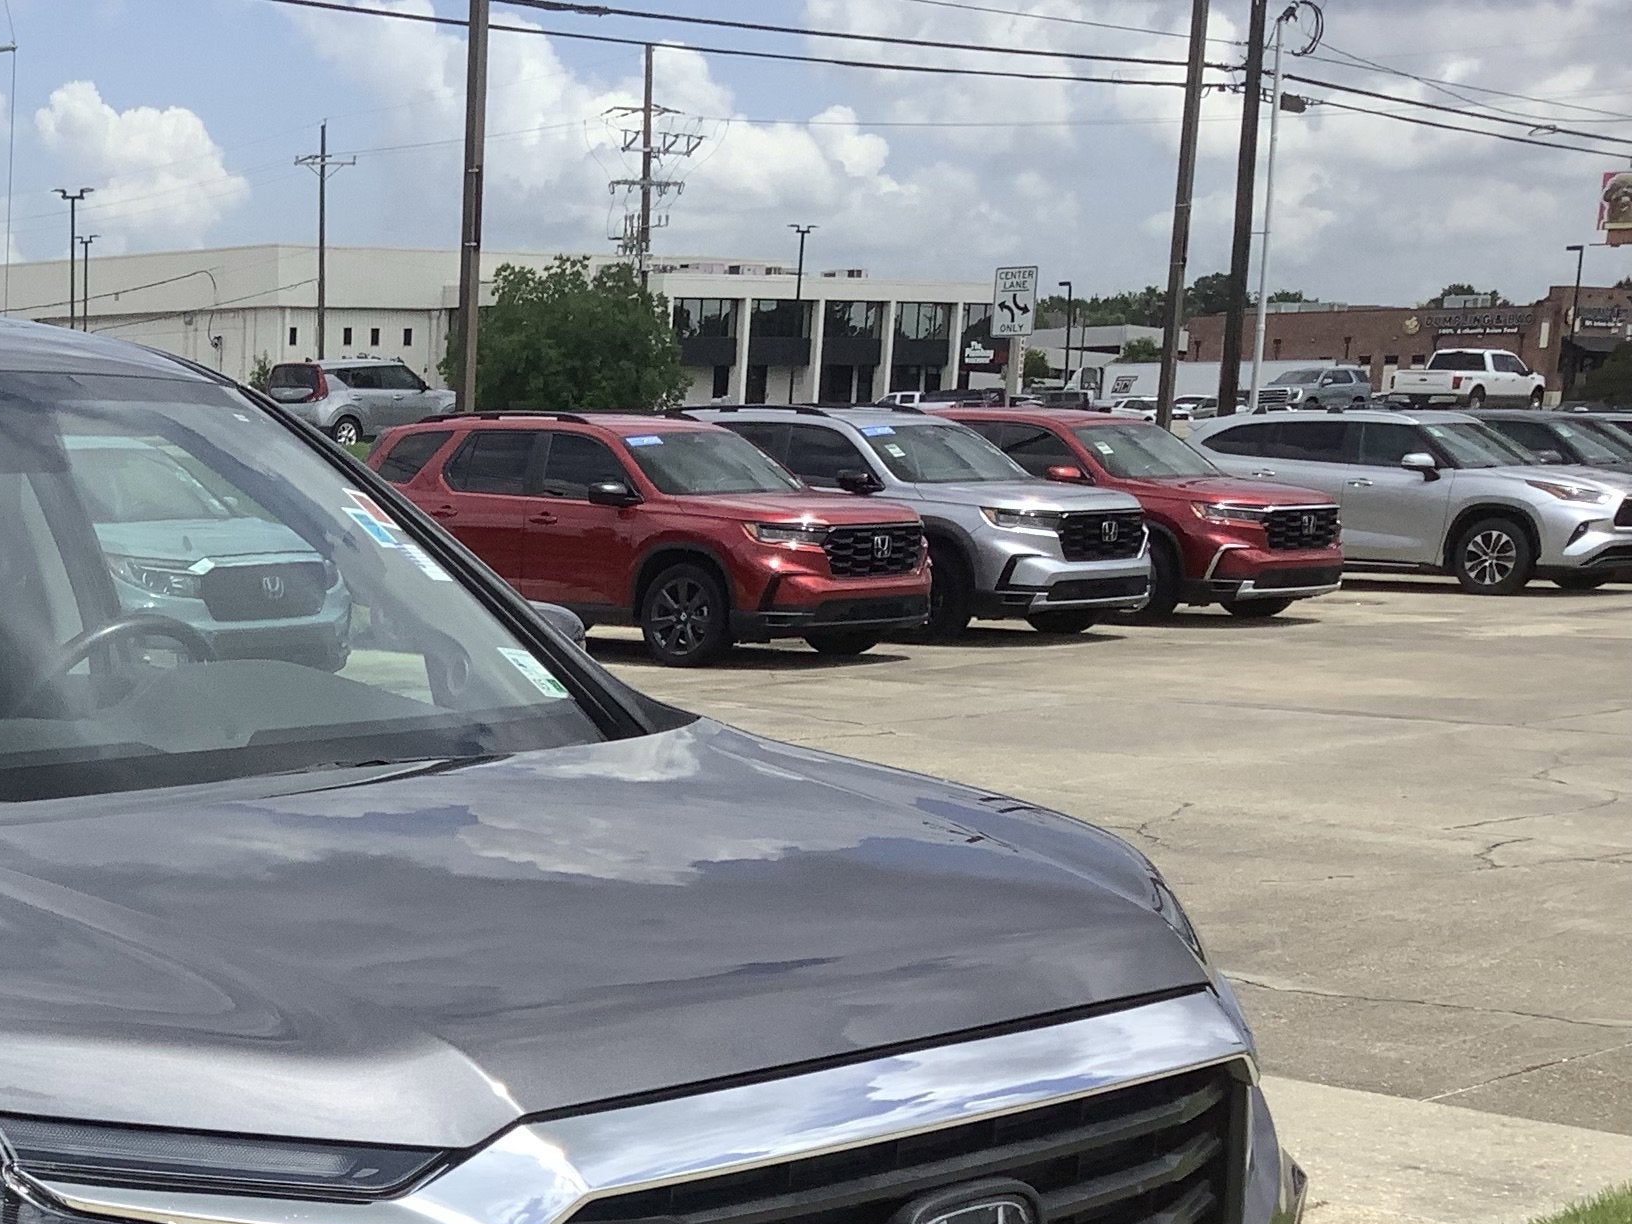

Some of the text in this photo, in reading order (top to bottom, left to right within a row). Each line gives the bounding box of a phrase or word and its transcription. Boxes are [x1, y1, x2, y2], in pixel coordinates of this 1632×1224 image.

[998, 270, 1034, 281] CENTER
[1003, 280, 1029, 290] LANE
[999, 323, 1024, 333] ONLY
